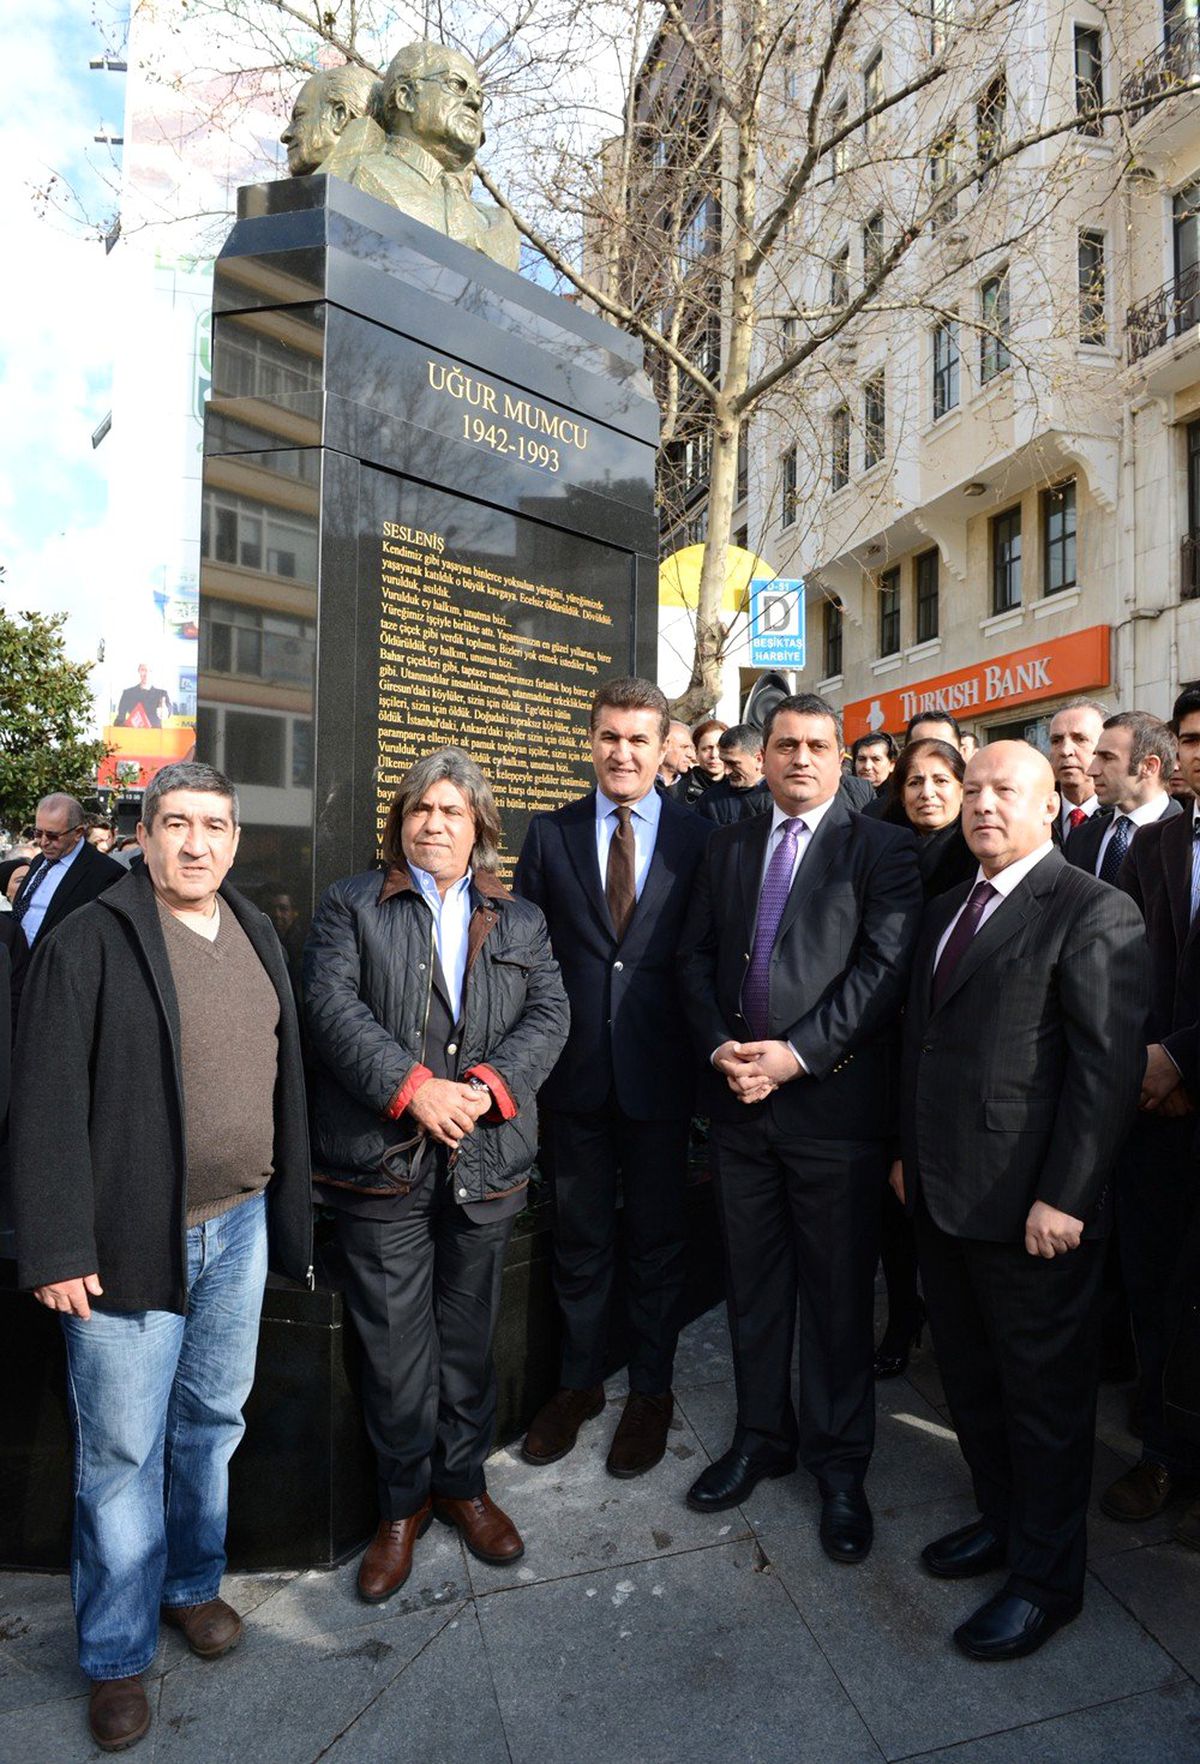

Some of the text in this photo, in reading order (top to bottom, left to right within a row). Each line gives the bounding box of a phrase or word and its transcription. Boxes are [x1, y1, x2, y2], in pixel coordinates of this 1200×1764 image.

[427, 360, 588, 449] UĞUR MUMCU
[463, 414, 559, 472] 1942-1993
[383, 521, 445, 554] SESLENİŞ
[383, 541, 422, 560] Kendimiz
[424, 553, 440, 566] gibi
[382, 586, 419, 605] Vurulduk
[421, 599, 431, 611] ey
[764, 595, 790, 631] D
[381, 620, 398, 632] taze
[422, 627, 438, 640] gibi
[753, 636, 803, 649] BEŞİKTAŞ
[380, 647, 405, 662] Bahar
[755, 650, 801, 661] HARBİYE
[901, 657, 1053, 722] TURKISH BANK
[460, 738, 469, 746] ak
